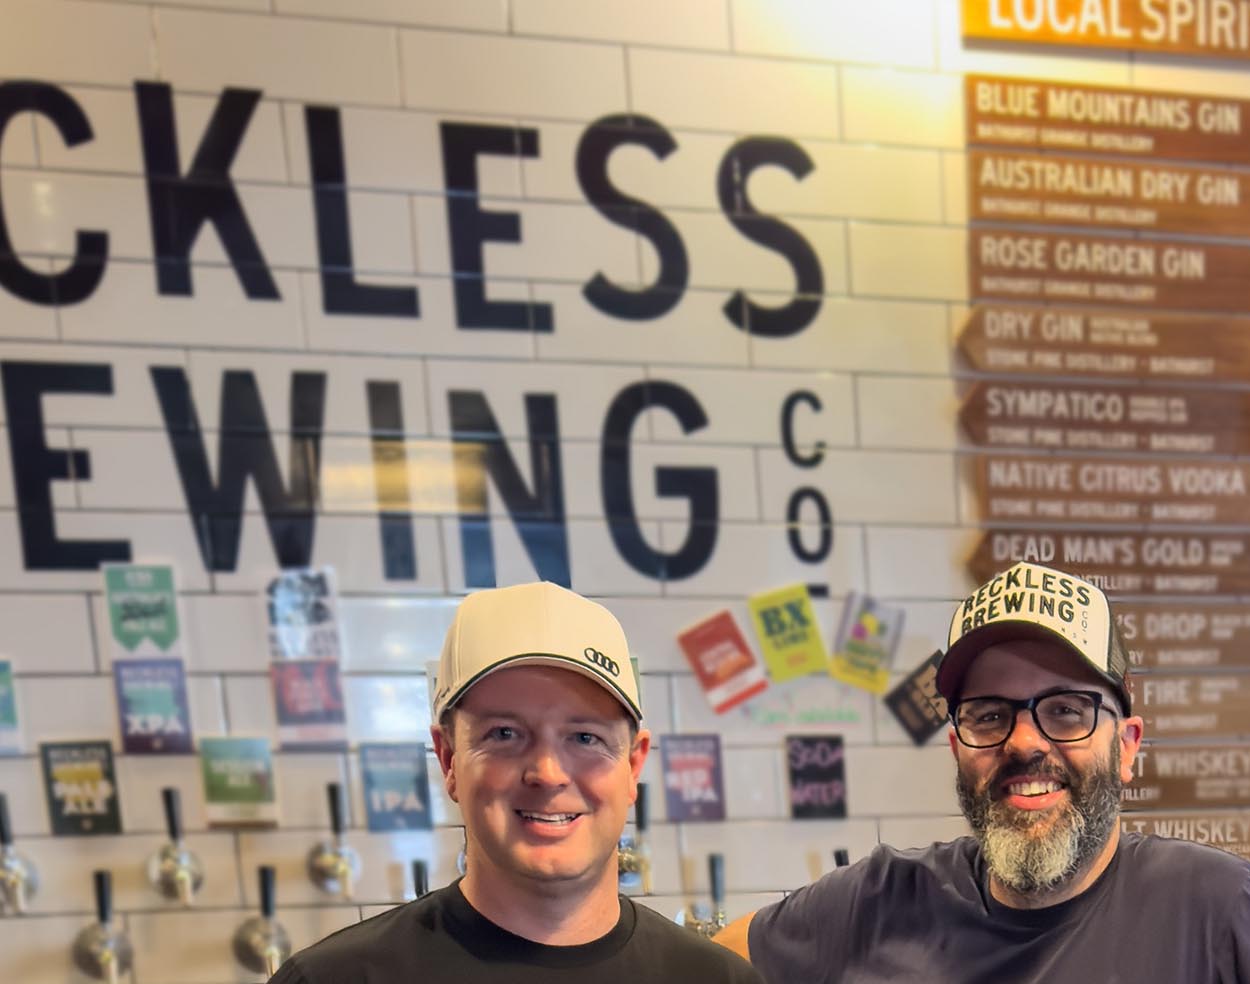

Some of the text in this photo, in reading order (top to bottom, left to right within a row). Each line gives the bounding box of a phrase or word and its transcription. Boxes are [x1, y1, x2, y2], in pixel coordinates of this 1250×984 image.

[988, 0, 1132, 38] LOCAL
[975, 82, 1241, 135] BLUE MOUNTAINS GIN
[979, 157, 1240, 207] AUSTRALIAN DRY GIN
[0, 79, 825, 338] CKLESS
[980, 237, 1205, 280] ROSE GARDEN GIN
[984, 310, 1085, 342] DRY GIN
[986, 386, 1124, 422] SYMPATICO
[0, 359, 720, 589] EWING
[988, 460, 1247, 496] NATIVE CITRUS VODKA
[992, 534, 1056, 563] DEAD
[1062, 536, 1136, 565] MAN'S
[1141, 538, 1206, 566] GOLD
[962, 567, 1091, 618] RECKLESS
[759, 598, 813, 638] BX
[961, 591, 1075, 636] BREWING
[1144, 613, 1206, 640] DROP
[1143, 679, 1192, 706] FIRE
[125, 713, 186, 736] XPA
[370, 789, 425, 813] IPA
